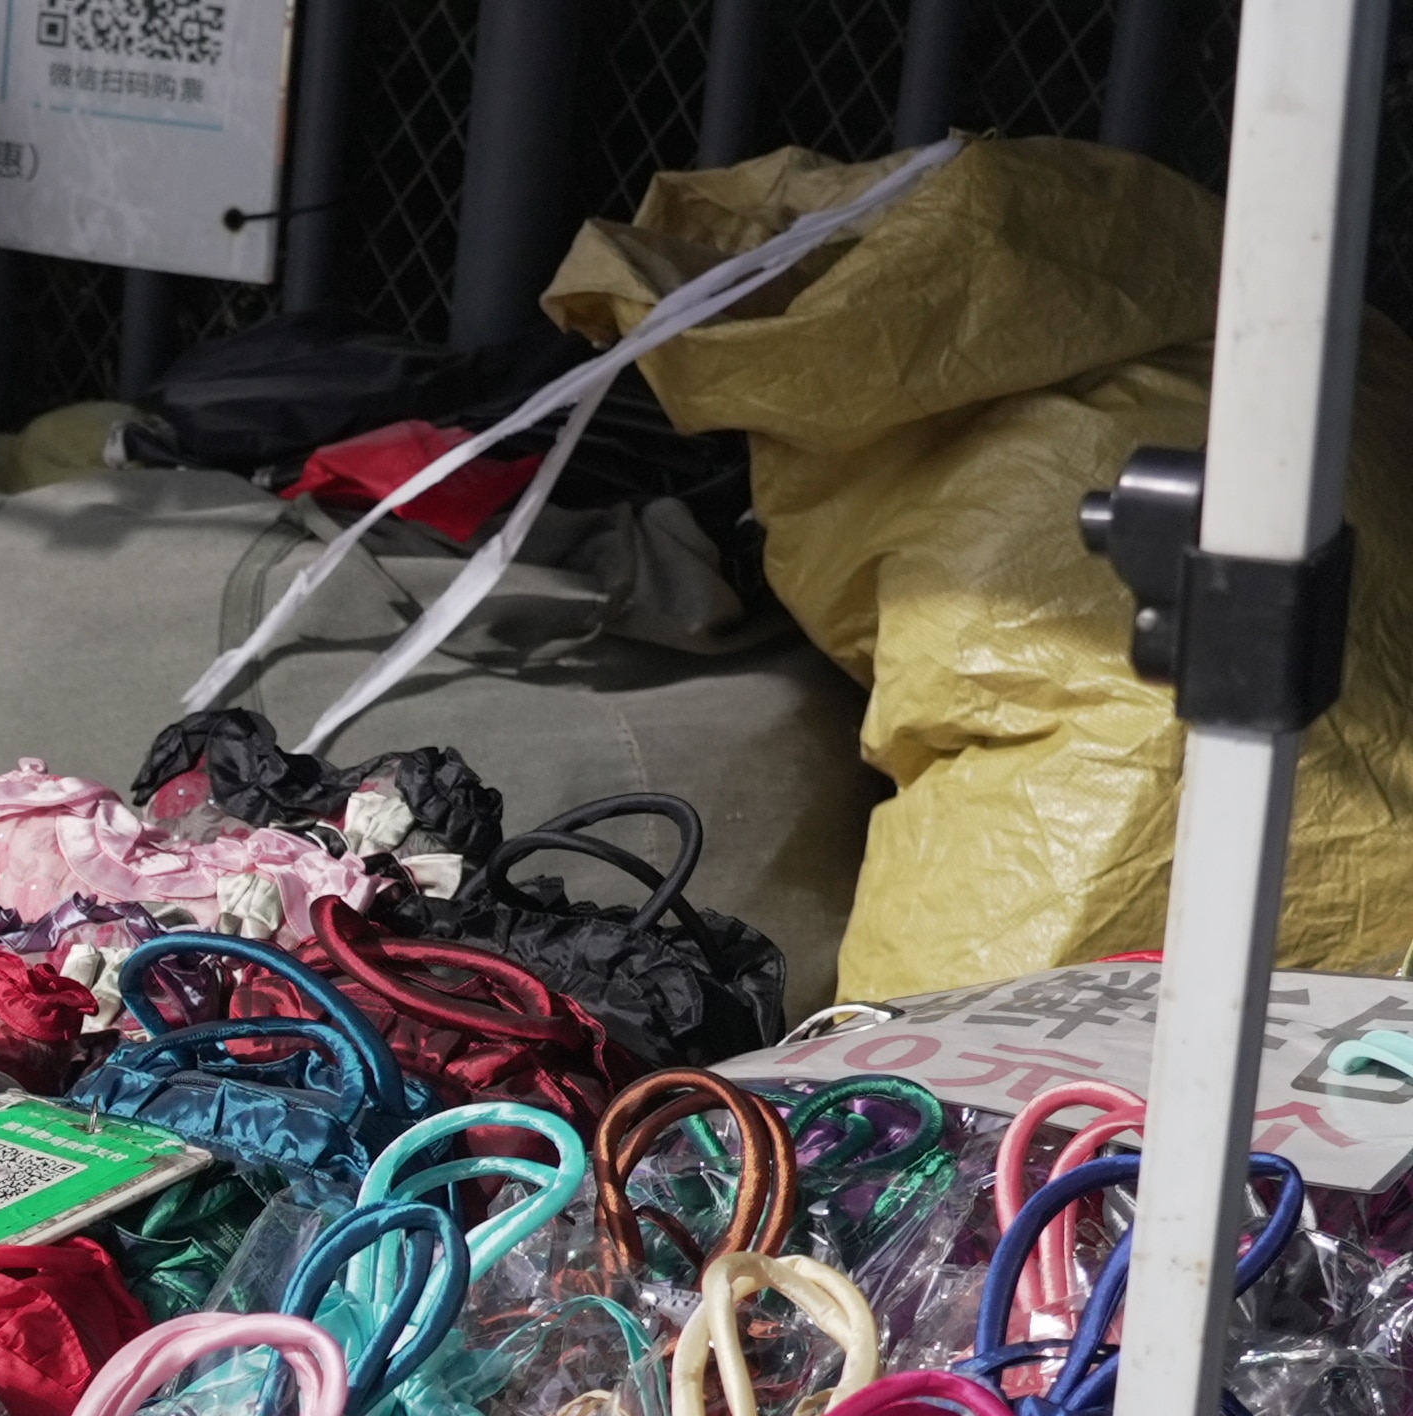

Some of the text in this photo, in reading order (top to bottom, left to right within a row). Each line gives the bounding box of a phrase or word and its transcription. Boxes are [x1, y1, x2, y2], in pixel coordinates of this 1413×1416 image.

[48, 61, 205, 103] 微信扫码购票
